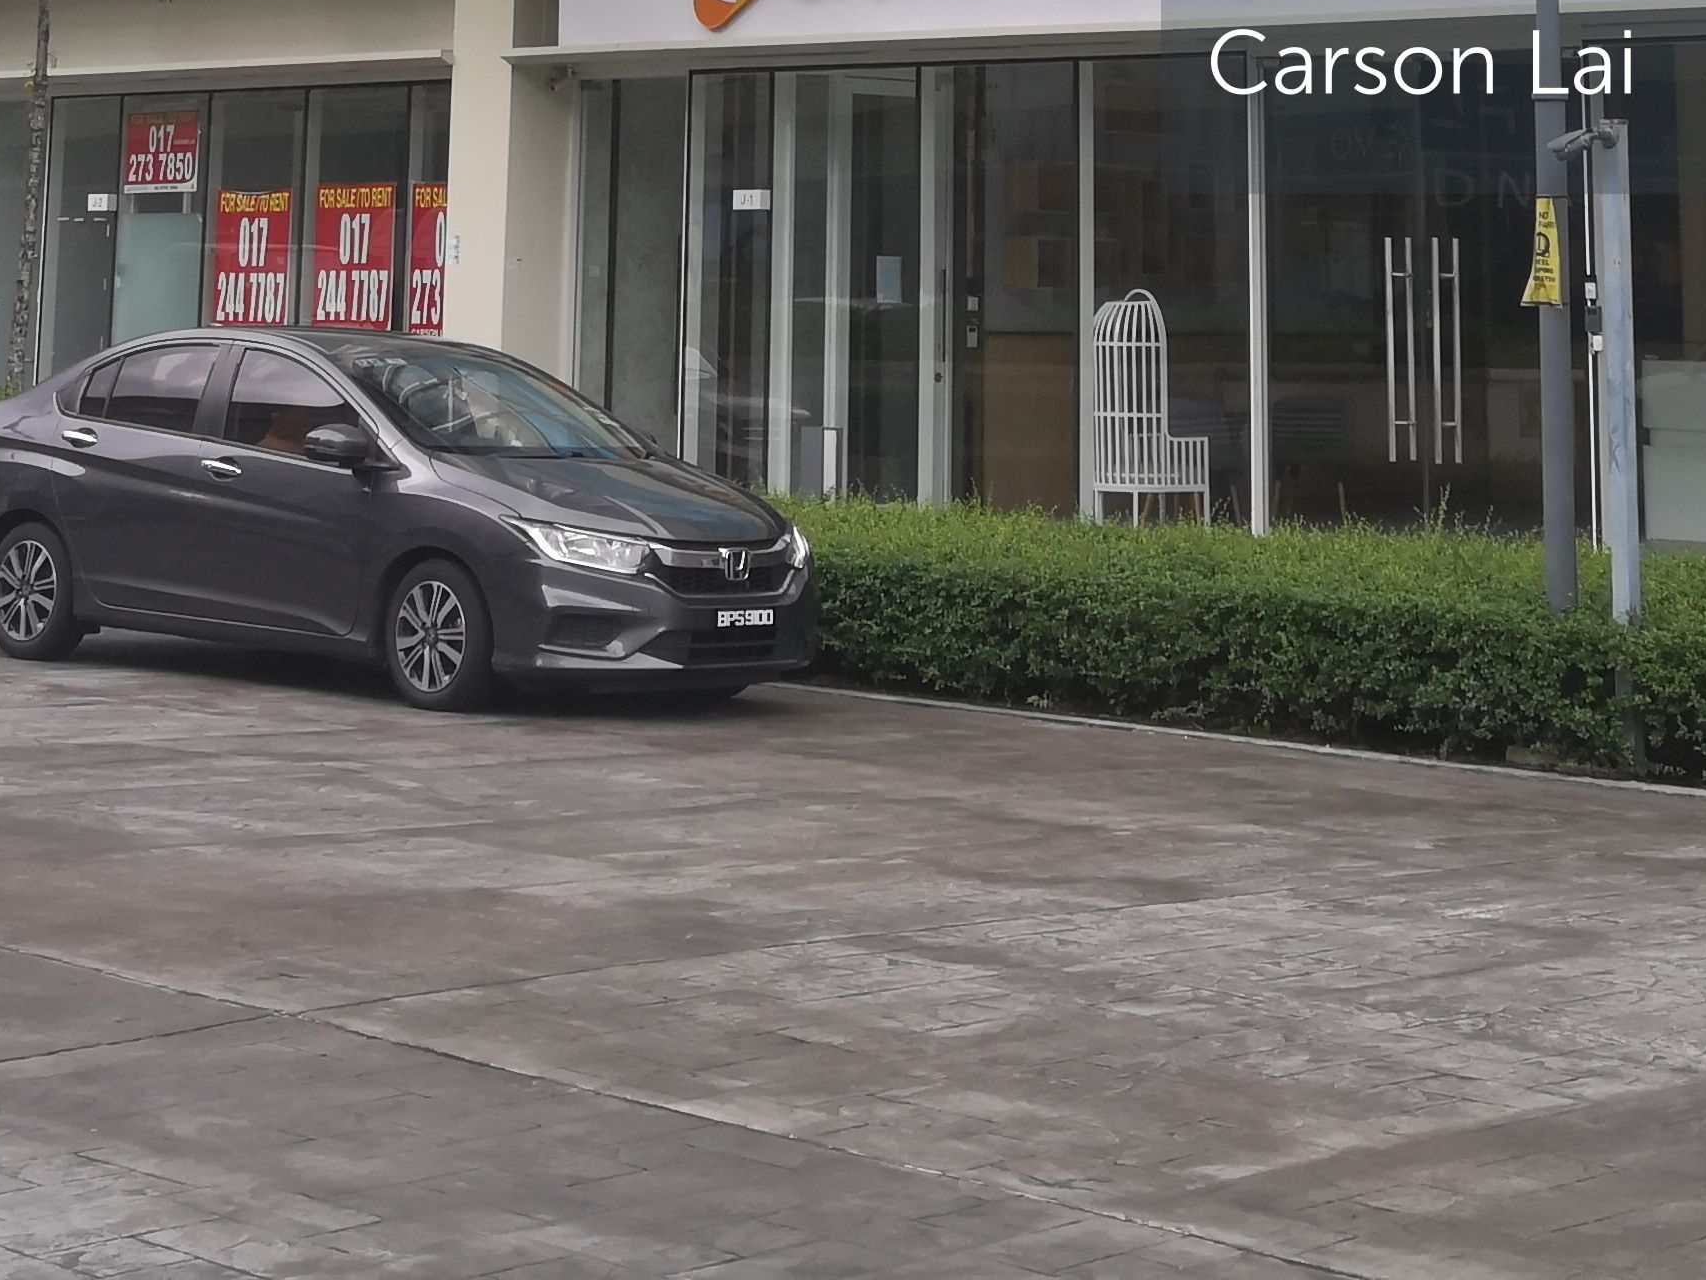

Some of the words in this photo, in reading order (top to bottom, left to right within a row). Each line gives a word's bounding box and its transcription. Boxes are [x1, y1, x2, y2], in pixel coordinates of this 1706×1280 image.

[149, 125, 175, 153] 017
[128, 154, 153, 181] 273
[158, 152, 193, 181] 7850
[220, 193, 234, 212] FOR
[269, 192, 290, 212] RENT
[320, 189, 335, 208] FOR
[372, 187, 392, 208] RENT
[415, 188, 431, 207] FOR
[432, 188, 447, 207] SAL
[239, 217, 268, 267] 017
[340, 213, 370, 265] 017
[216, 272, 245, 321] 244
[249, 272, 285, 323] 7787
[316, 269, 347, 321] 244
[351, 269, 388, 322] 7787
[411, 269, 441, 325] 273
